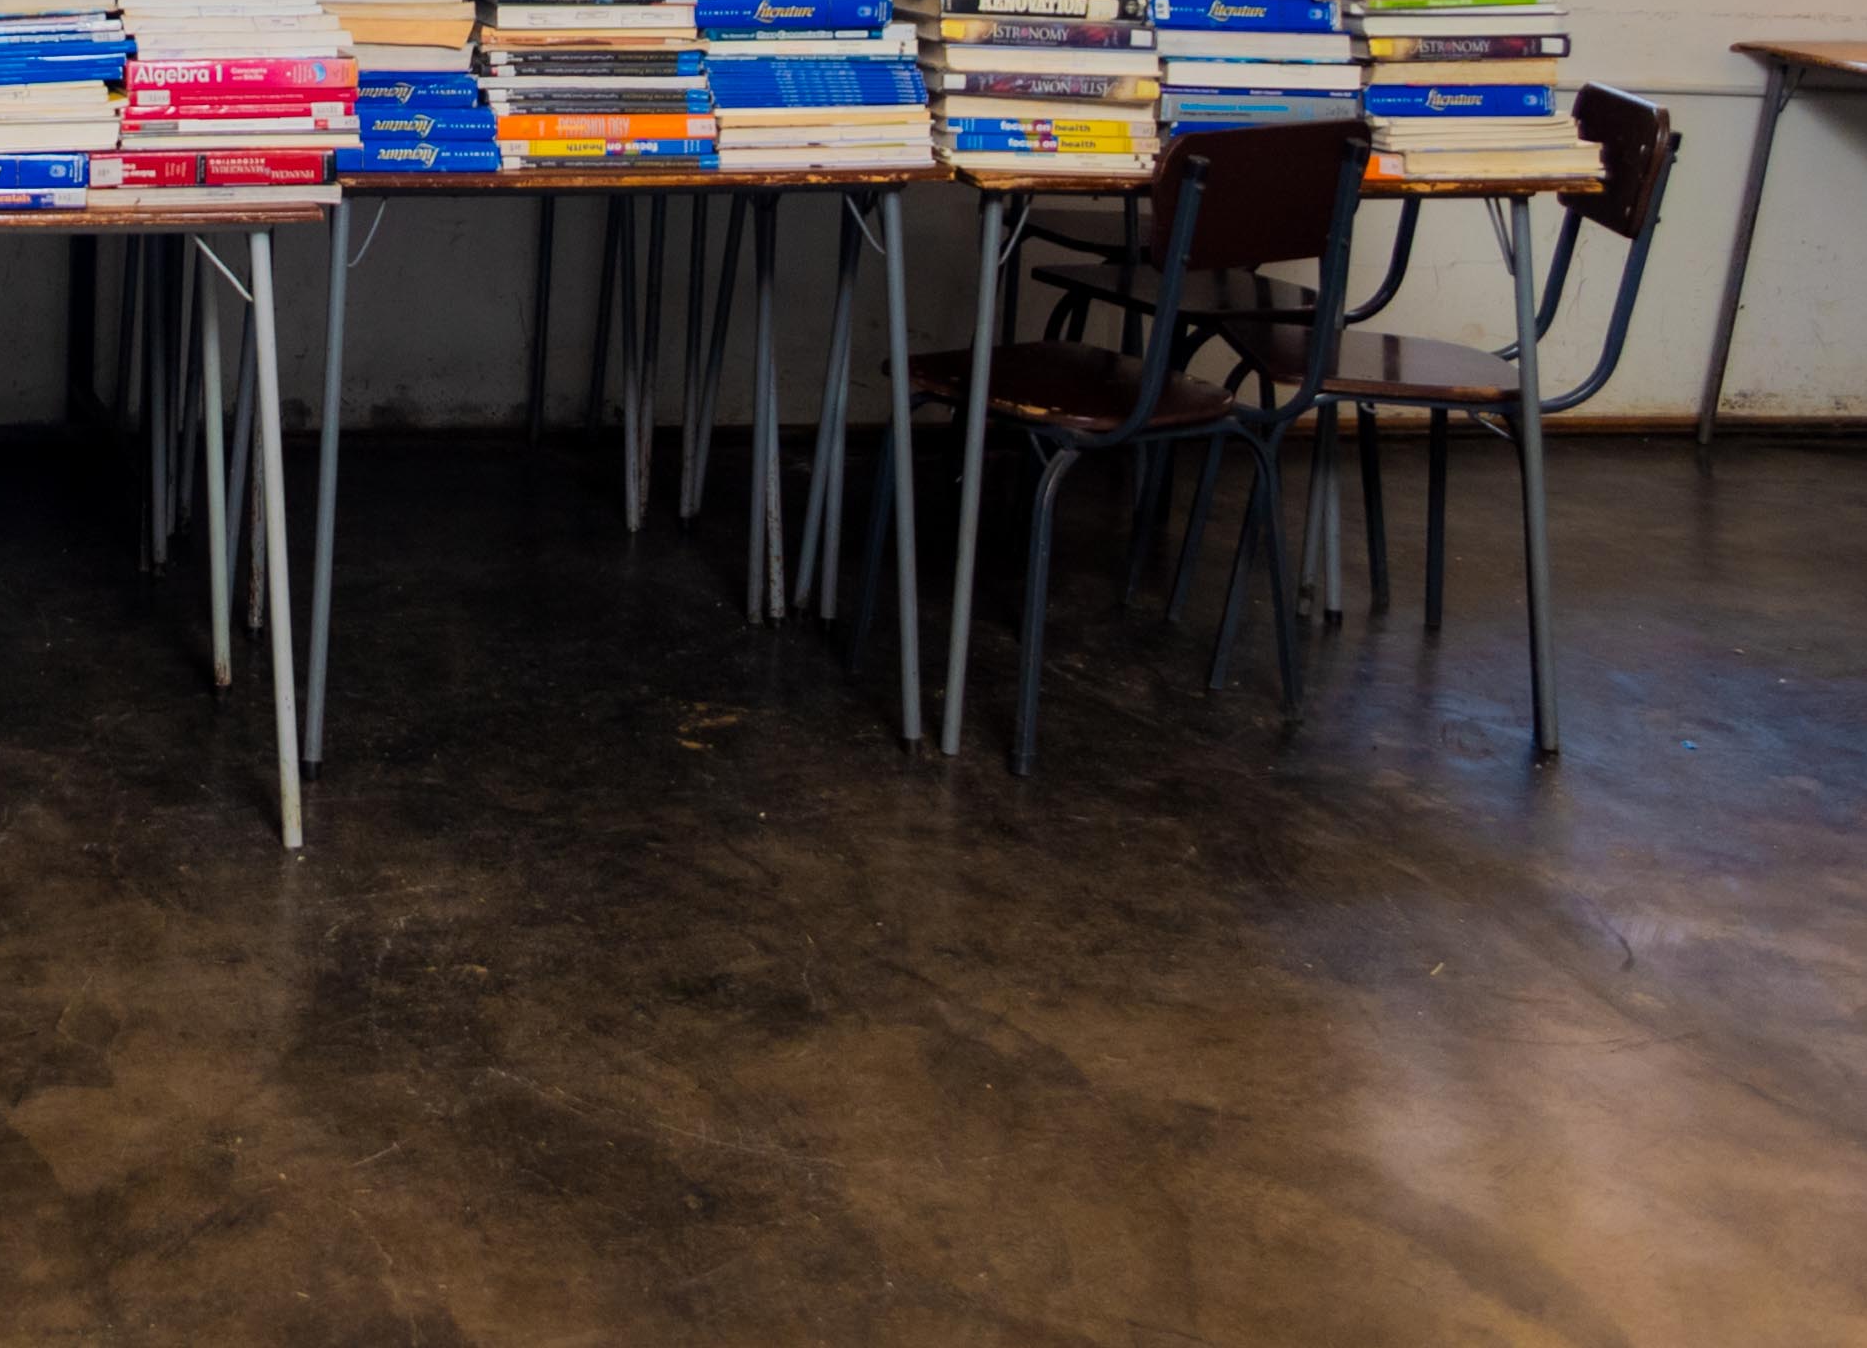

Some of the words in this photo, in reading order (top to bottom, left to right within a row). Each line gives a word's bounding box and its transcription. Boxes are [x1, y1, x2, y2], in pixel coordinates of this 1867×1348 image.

[752, 0, 815, 24] Literature
[984, 23, 1070, 41] ASTRONOMY
[1413, 38, 1491, 54] ASTRONOMY
[134, 65, 210, 86] Algebra
[215, 64, 223, 83] 1
[1030, 79, 1117, 97] ASTRONOMY
[1425, 88, 1483, 111] Literature
[372, 114, 436, 139] Literature
[1000, 121, 1033, 132] focus
[1035, 122, 1052, 132] on
[1054, 122, 1091, 133] health
[606, 142, 623, 151] on
[625, 141, 659, 152] focus
[1008, 137, 1039, 149] focus
[1042, 138, 1057, 149] on
[1061, 139, 1097, 149] health
[377, 142, 440, 169] Literature
